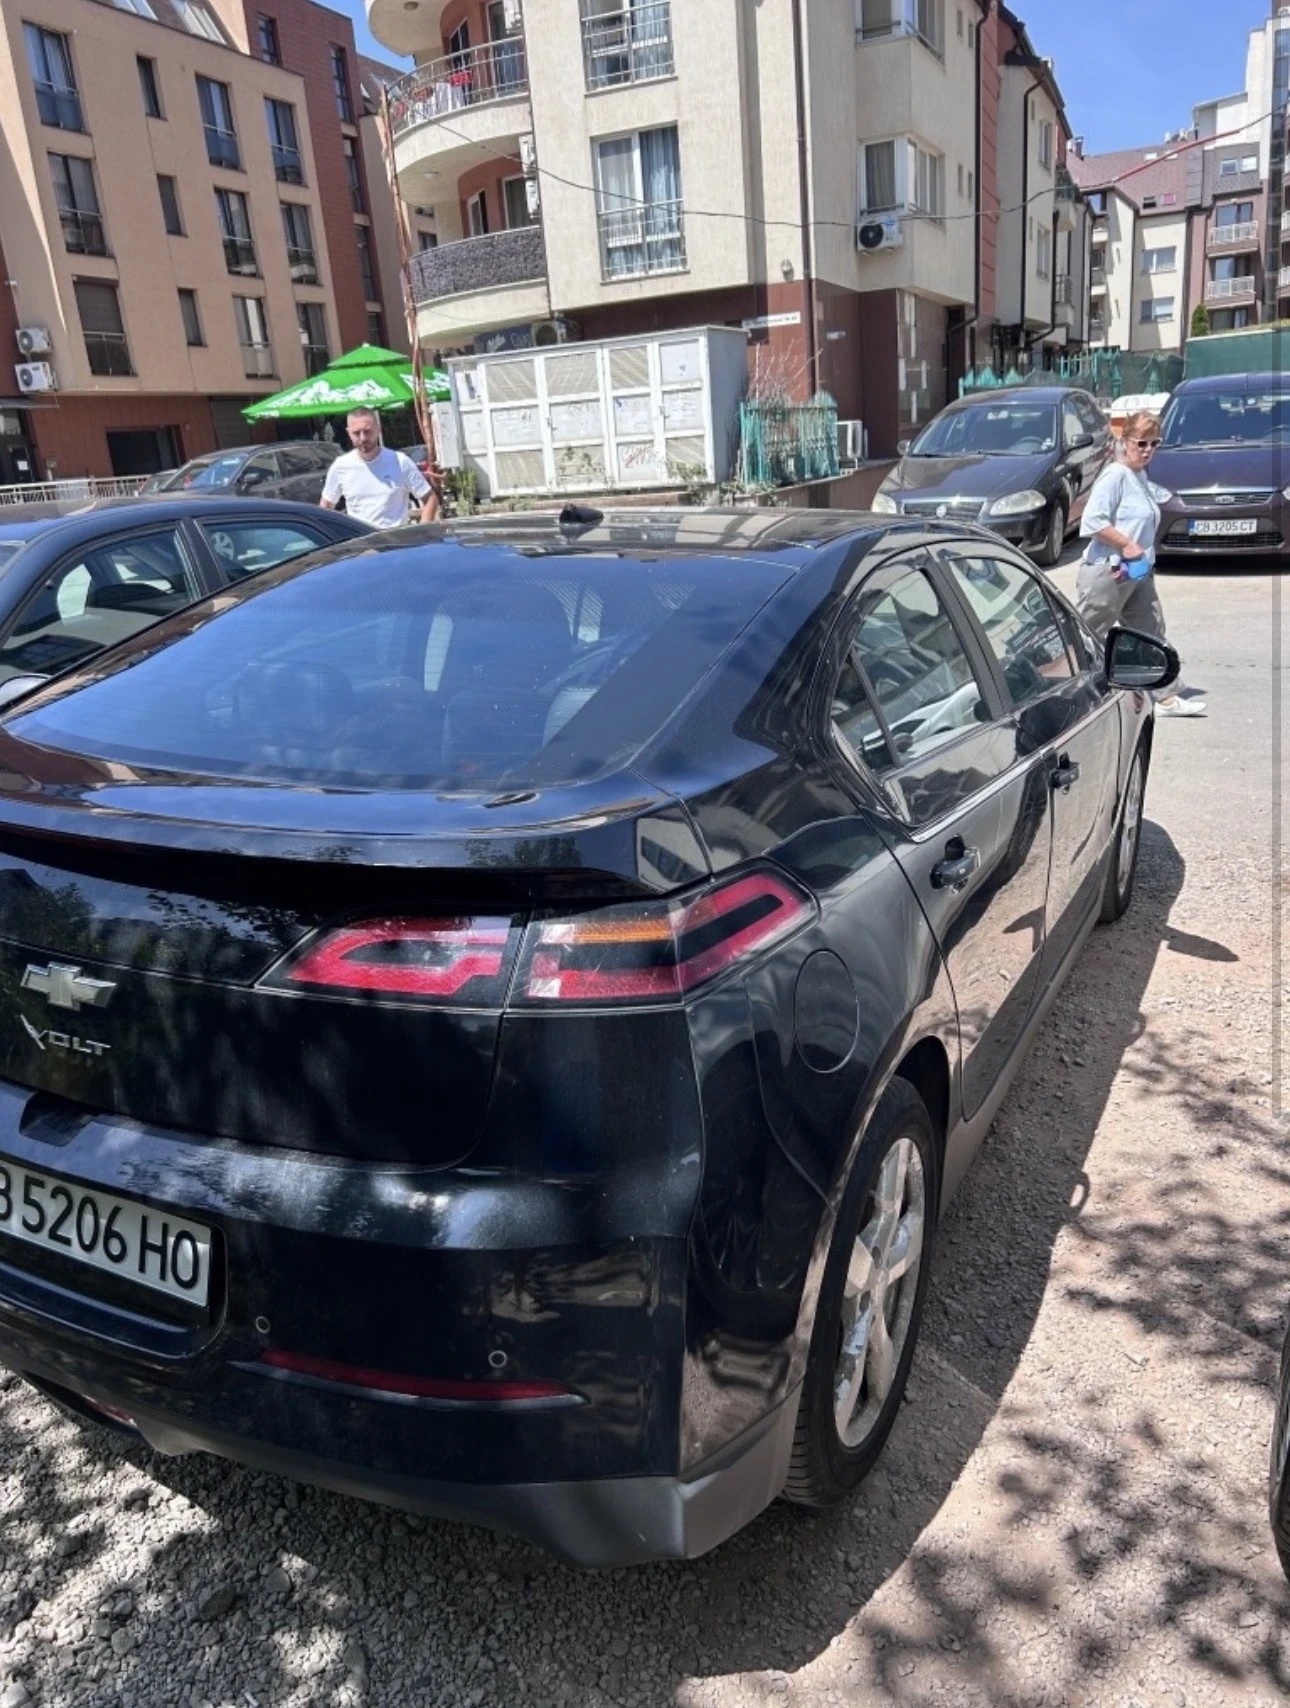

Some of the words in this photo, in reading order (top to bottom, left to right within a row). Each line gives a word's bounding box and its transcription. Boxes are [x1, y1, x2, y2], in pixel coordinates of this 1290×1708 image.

[1212, 521, 1238, 533] 3205
[1240, 520, 1254, 532] CT
[20, 1013, 111, 1055] VOLT
[22, 1175, 127, 1263] 5206
